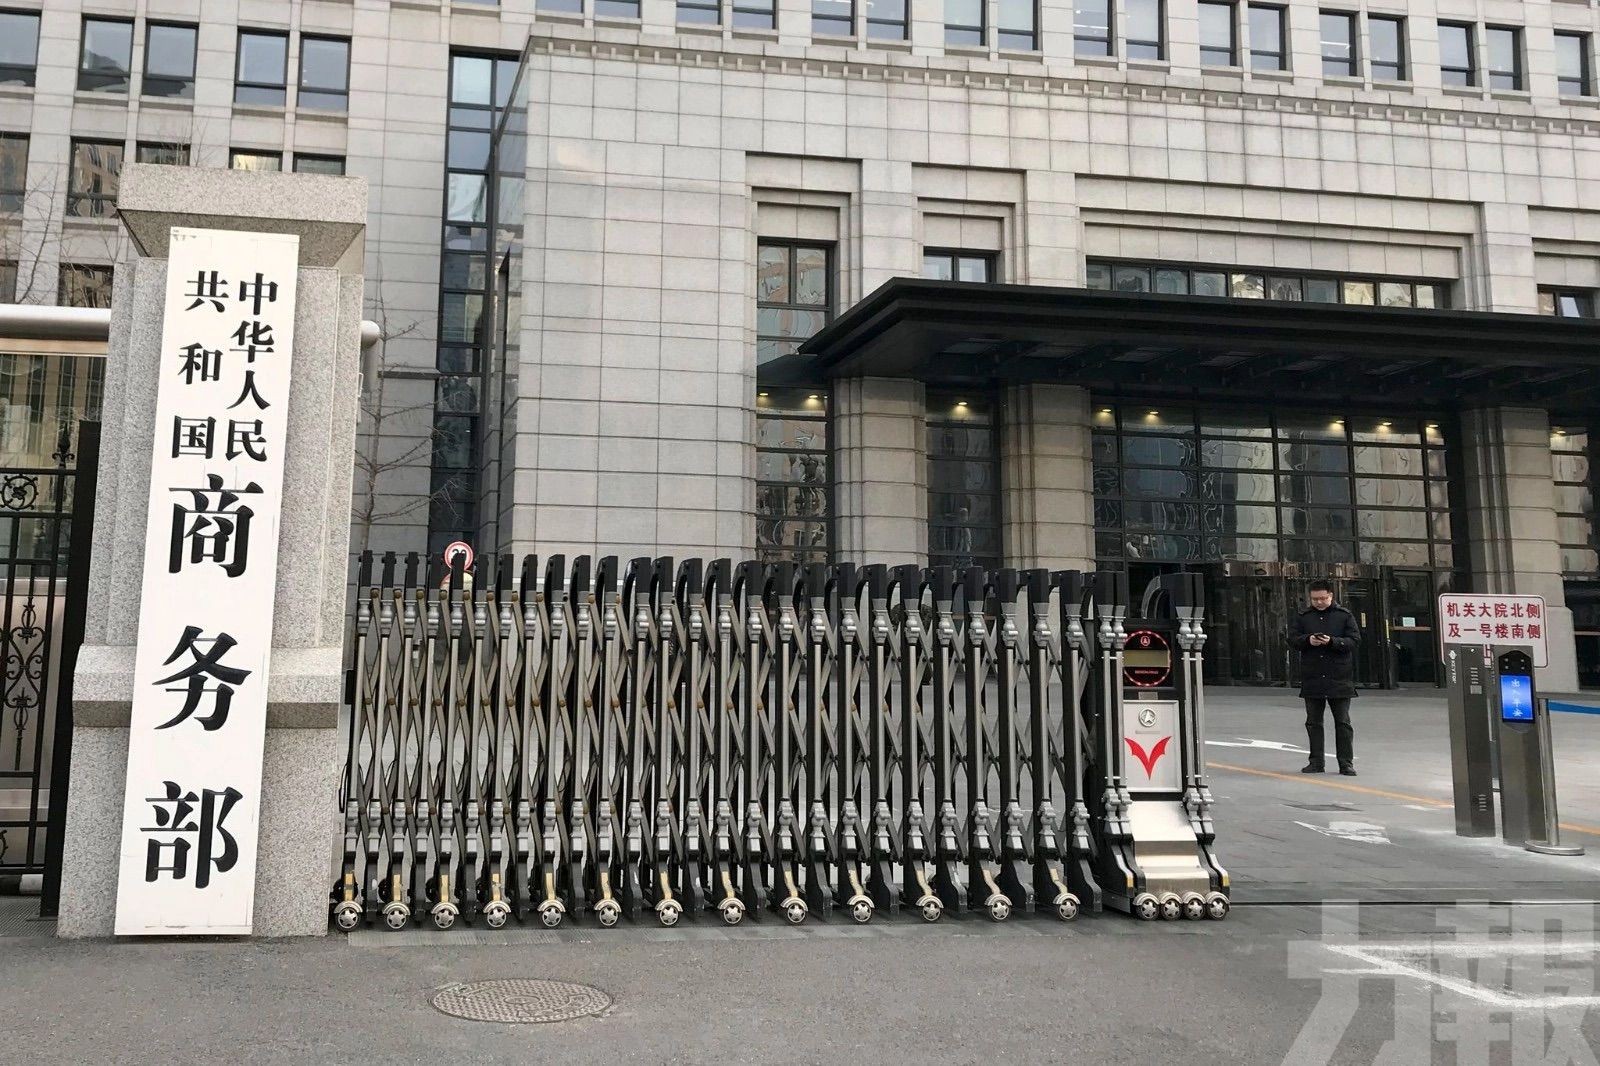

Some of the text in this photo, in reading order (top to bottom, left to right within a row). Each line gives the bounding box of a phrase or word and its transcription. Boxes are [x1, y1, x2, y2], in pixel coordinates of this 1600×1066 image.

[172, 270, 229, 460] 共和国
[226, 273, 278, 462] 中华人民
[141, 473, 264, 889] 商务部
[1447, 602, 1541, 619] 机关大院北侧
[1448, 623, 1541, 639] 及一号楼南侧
